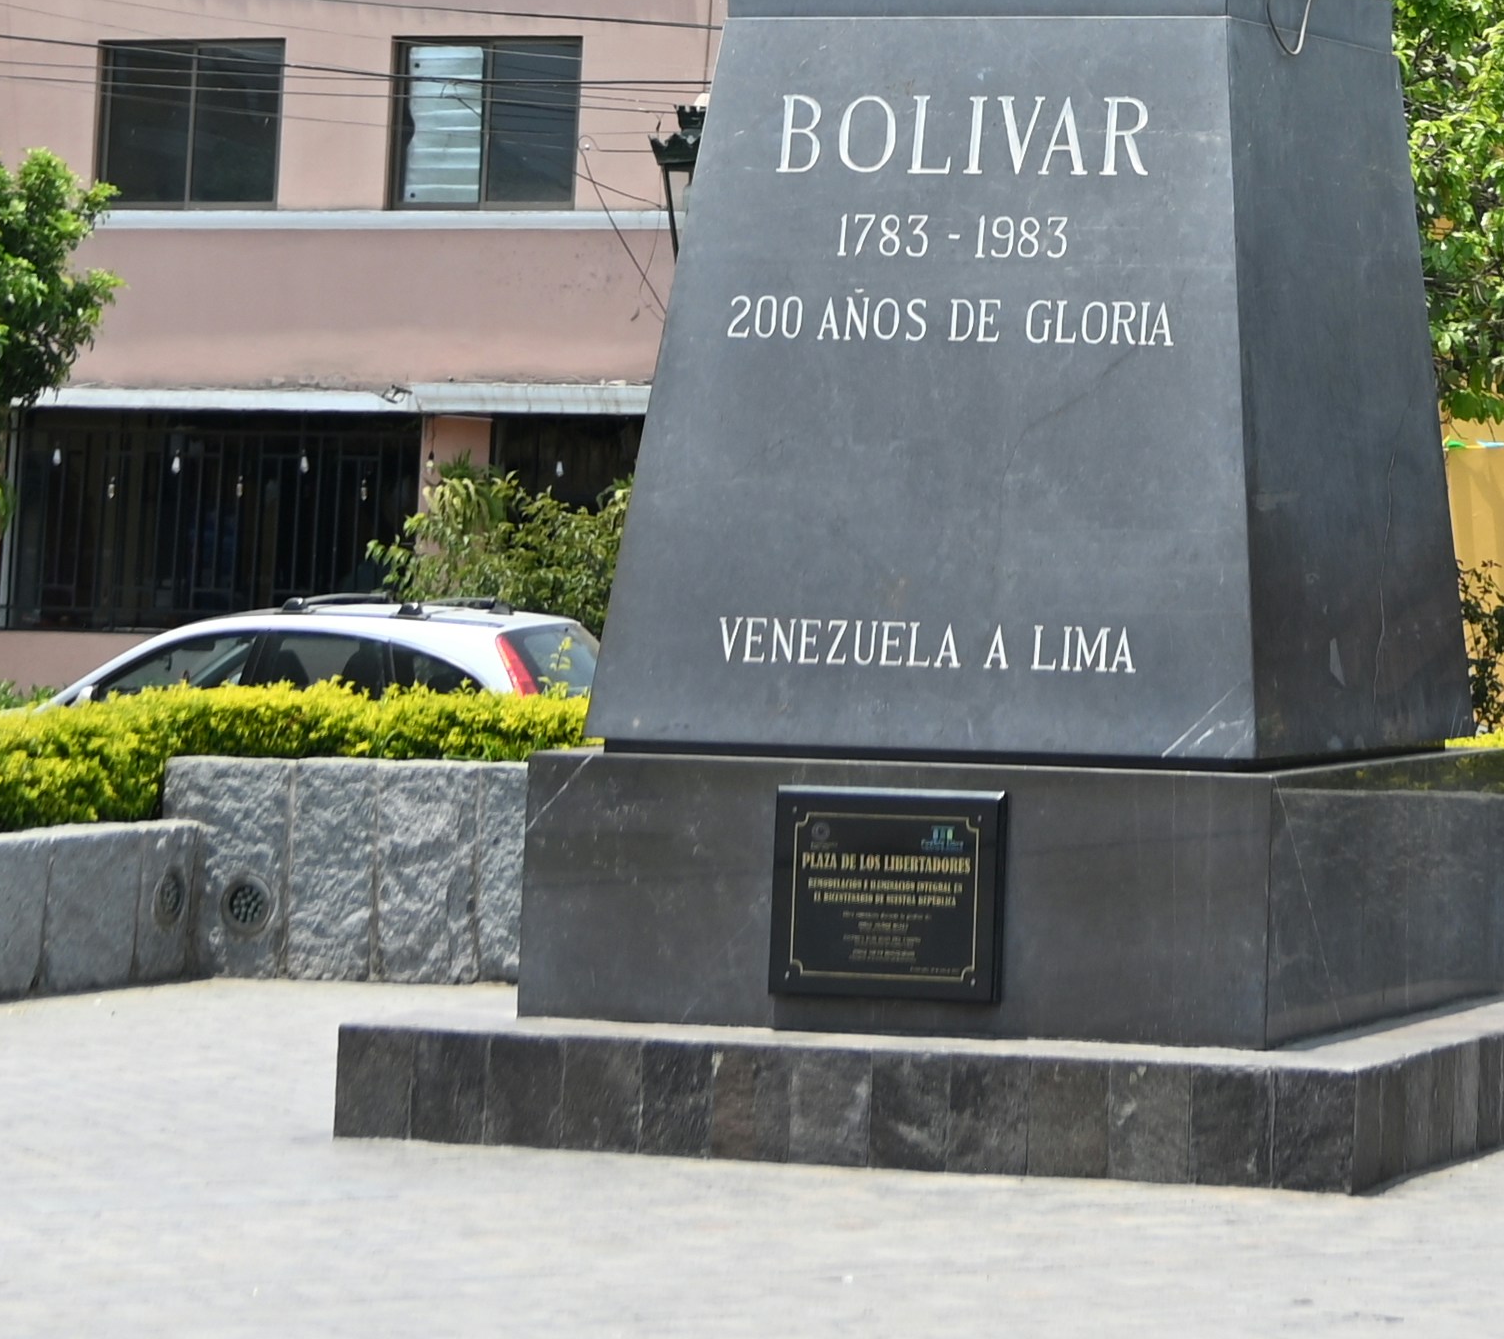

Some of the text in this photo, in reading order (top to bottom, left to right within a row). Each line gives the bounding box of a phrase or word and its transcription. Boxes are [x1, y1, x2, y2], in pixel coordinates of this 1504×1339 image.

[776, 93, 1149, 177] BOLIVAR
[837, 213, 929, 258] 1783
[974, 214, 1068, 259] 1983
[727, 288, 1174, 347] 200 AÑOS DE GLORIA
[719, 616, 1137, 674] VENEZUELA A LIMA
[802, 852, 971, 873] PLAZA DE LOS LIBERTADORES
